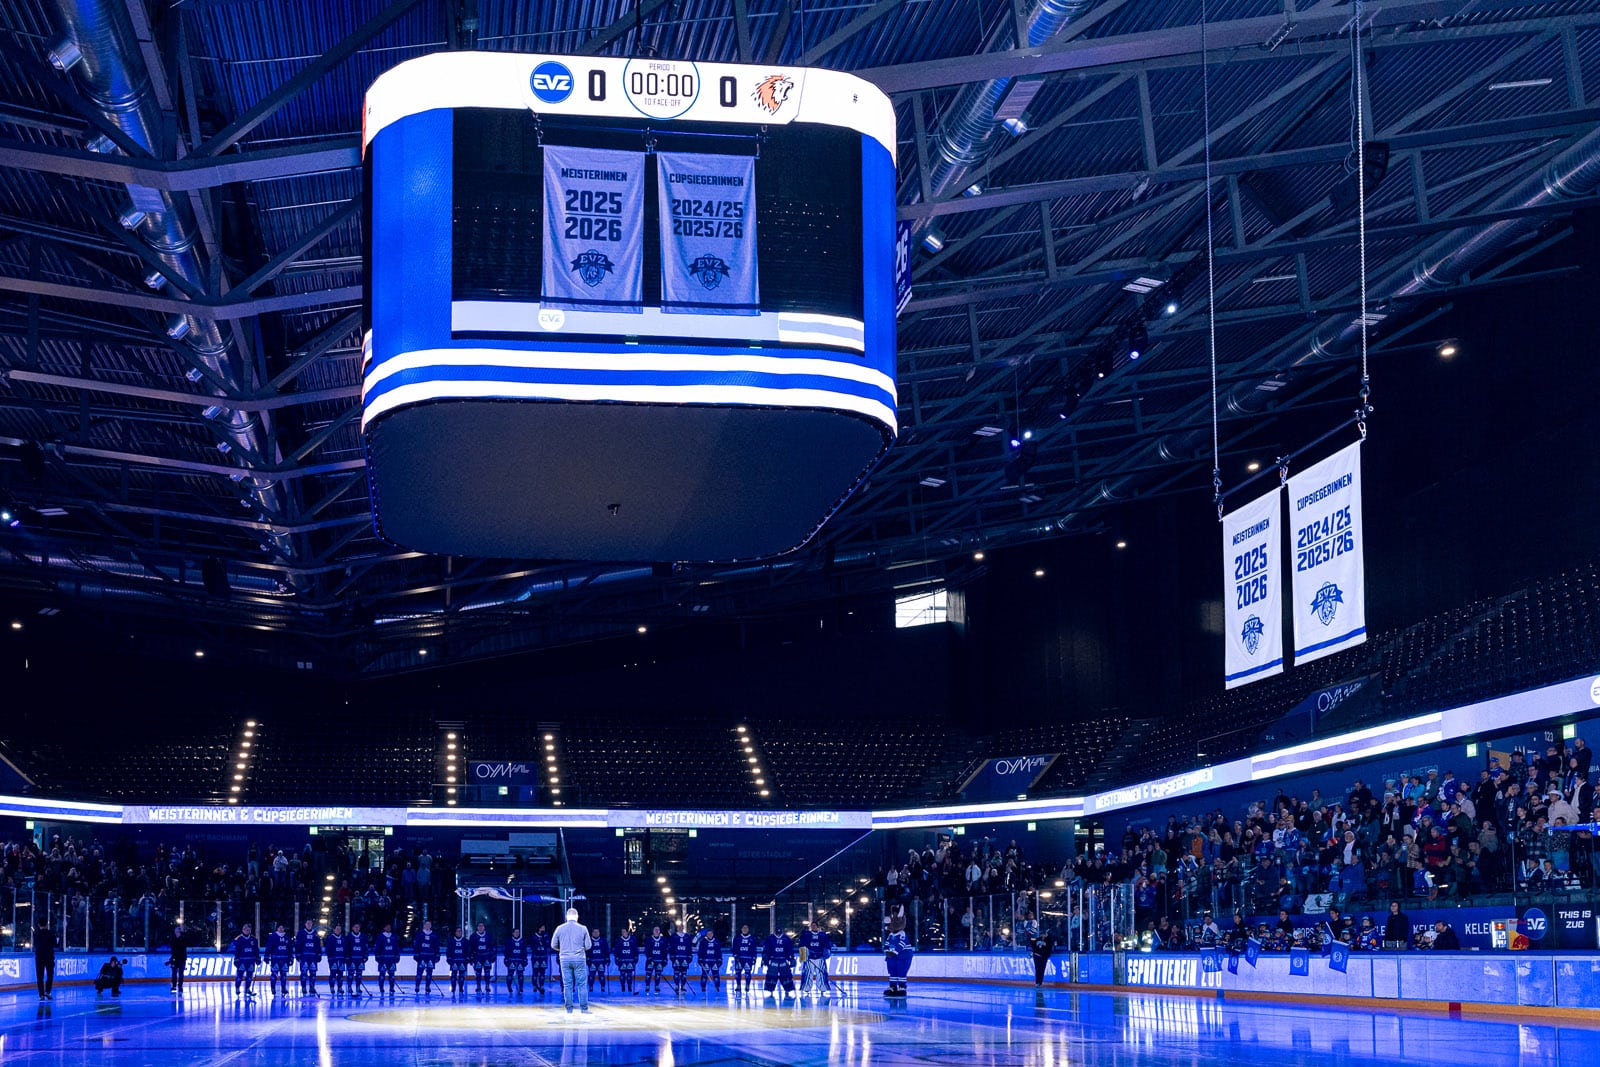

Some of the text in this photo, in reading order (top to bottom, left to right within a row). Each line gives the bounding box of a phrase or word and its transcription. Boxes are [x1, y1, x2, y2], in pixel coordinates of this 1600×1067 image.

[533, 73, 572, 91] EVZ
[588, 69, 606, 102] 0
[631, 72, 693, 97] 00:00
[719, 76, 737, 108] 0
[561, 167, 628, 182] MEISTERINNEN
[669, 173, 744, 187] CUPSIEGERINNEN
[565, 189, 622, 214] 2025
[671, 199, 743, 218] 2024/25
[565, 216, 622, 242] 2026
[673, 218, 743, 239] 2025/26
[580, 254, 606, 265] EVZ
[698, 259, 722, 268] EVZ
[1297, 472, 1353, 511] CUPSIEGERINNEN
[1232, 517, 1270, 546] MEISTERINNEN
[1297, 505, 1352, 548] 2024/25
[1297, 530, 1354, 572] 2025/26
[1234, 543, 1268, 581] 2025
[1236, 574, 1268, 610] 2026
[1318, 586, 1337, 598] EVZ
[1544, 730, 1553, 742] 123
[1095, 787, 1142, 810] MEISTERINNEN
[1151, 767, 1213, 798] CUPSIEGERINNEN
[148, 808, 353, 822] MEISTERINNEN & CUPSIEGERINNEN
[646, 812, 839, 826] MEISTERINNEN & CUPSIEGERINNEN
[1559, 910, 1592, 919] THIS IS
[1565, 920, 1585, 929] ZUG
[836, 957, 858, 975] ZUG
[1127, 959, 1198, 986] SSPORTVEREIN
